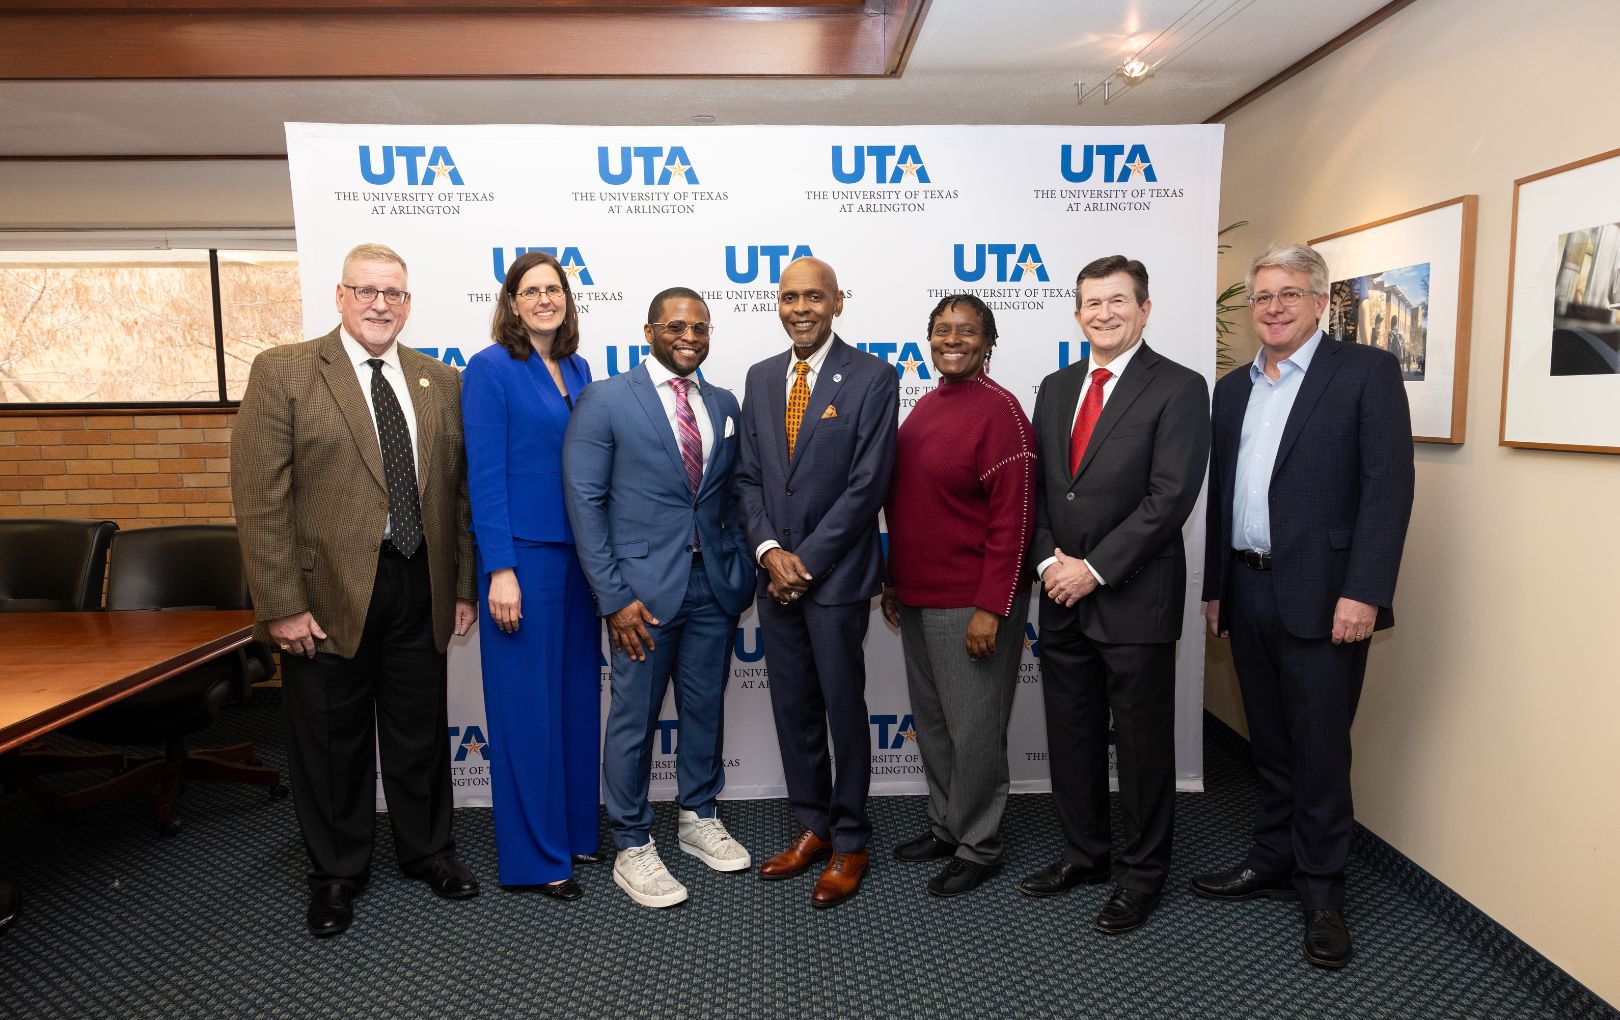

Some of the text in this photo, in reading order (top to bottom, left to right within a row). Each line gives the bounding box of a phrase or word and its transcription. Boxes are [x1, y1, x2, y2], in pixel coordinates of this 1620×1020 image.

[358, 145, 465, 186] UTA
[597, 145, 700, 186] UTA
[831, 144, 932, 185] UTA
[1060, 143, 1158, 183] UTA
[334, 191, 495, 202] THE UNIVERSITY OF TEXAS
[571, 191, 729, 202] THE UNIVERSITY OF TEXAS
[804, 189, 959, 201] THE UNIVERSITY OF TEXAS
[1033, 188, 1184, 199] THE UNIVERSITY OF TEXAS
[371, 205, 460, 215] AT ARLINGTON
[607, 204, 695, 214] AT ARLINGTON
[839, 203, 925, 213] AT ARLINGTON
[1066, 201, 1151, 212] AT ARLINGTON
[953, 243, 1051, 282] UTA
[467, 293, 492, 303] THE
[586, 291, 623, 301] TEXAS
[700, 290, 780, 300] THE UNIVERSI
[927, 288, 1076, 298] THE UNIVERSITY OF TEXAS
[733, 303, 748, 312] AT
[986, 301, 1044, 310] RLINGTON
[856, 342, 932, 380] TA
[905, 386, 921, 395] OF
[1019, 663, 1034, 672] OF
[741, 680, 755, 689] AT
[904, 754, 919, 763] OF
[1025, 752, 1048, 761] THE
[469, 766, 484, 775] OF
[870, 765, 924, 775] RLINGTON
